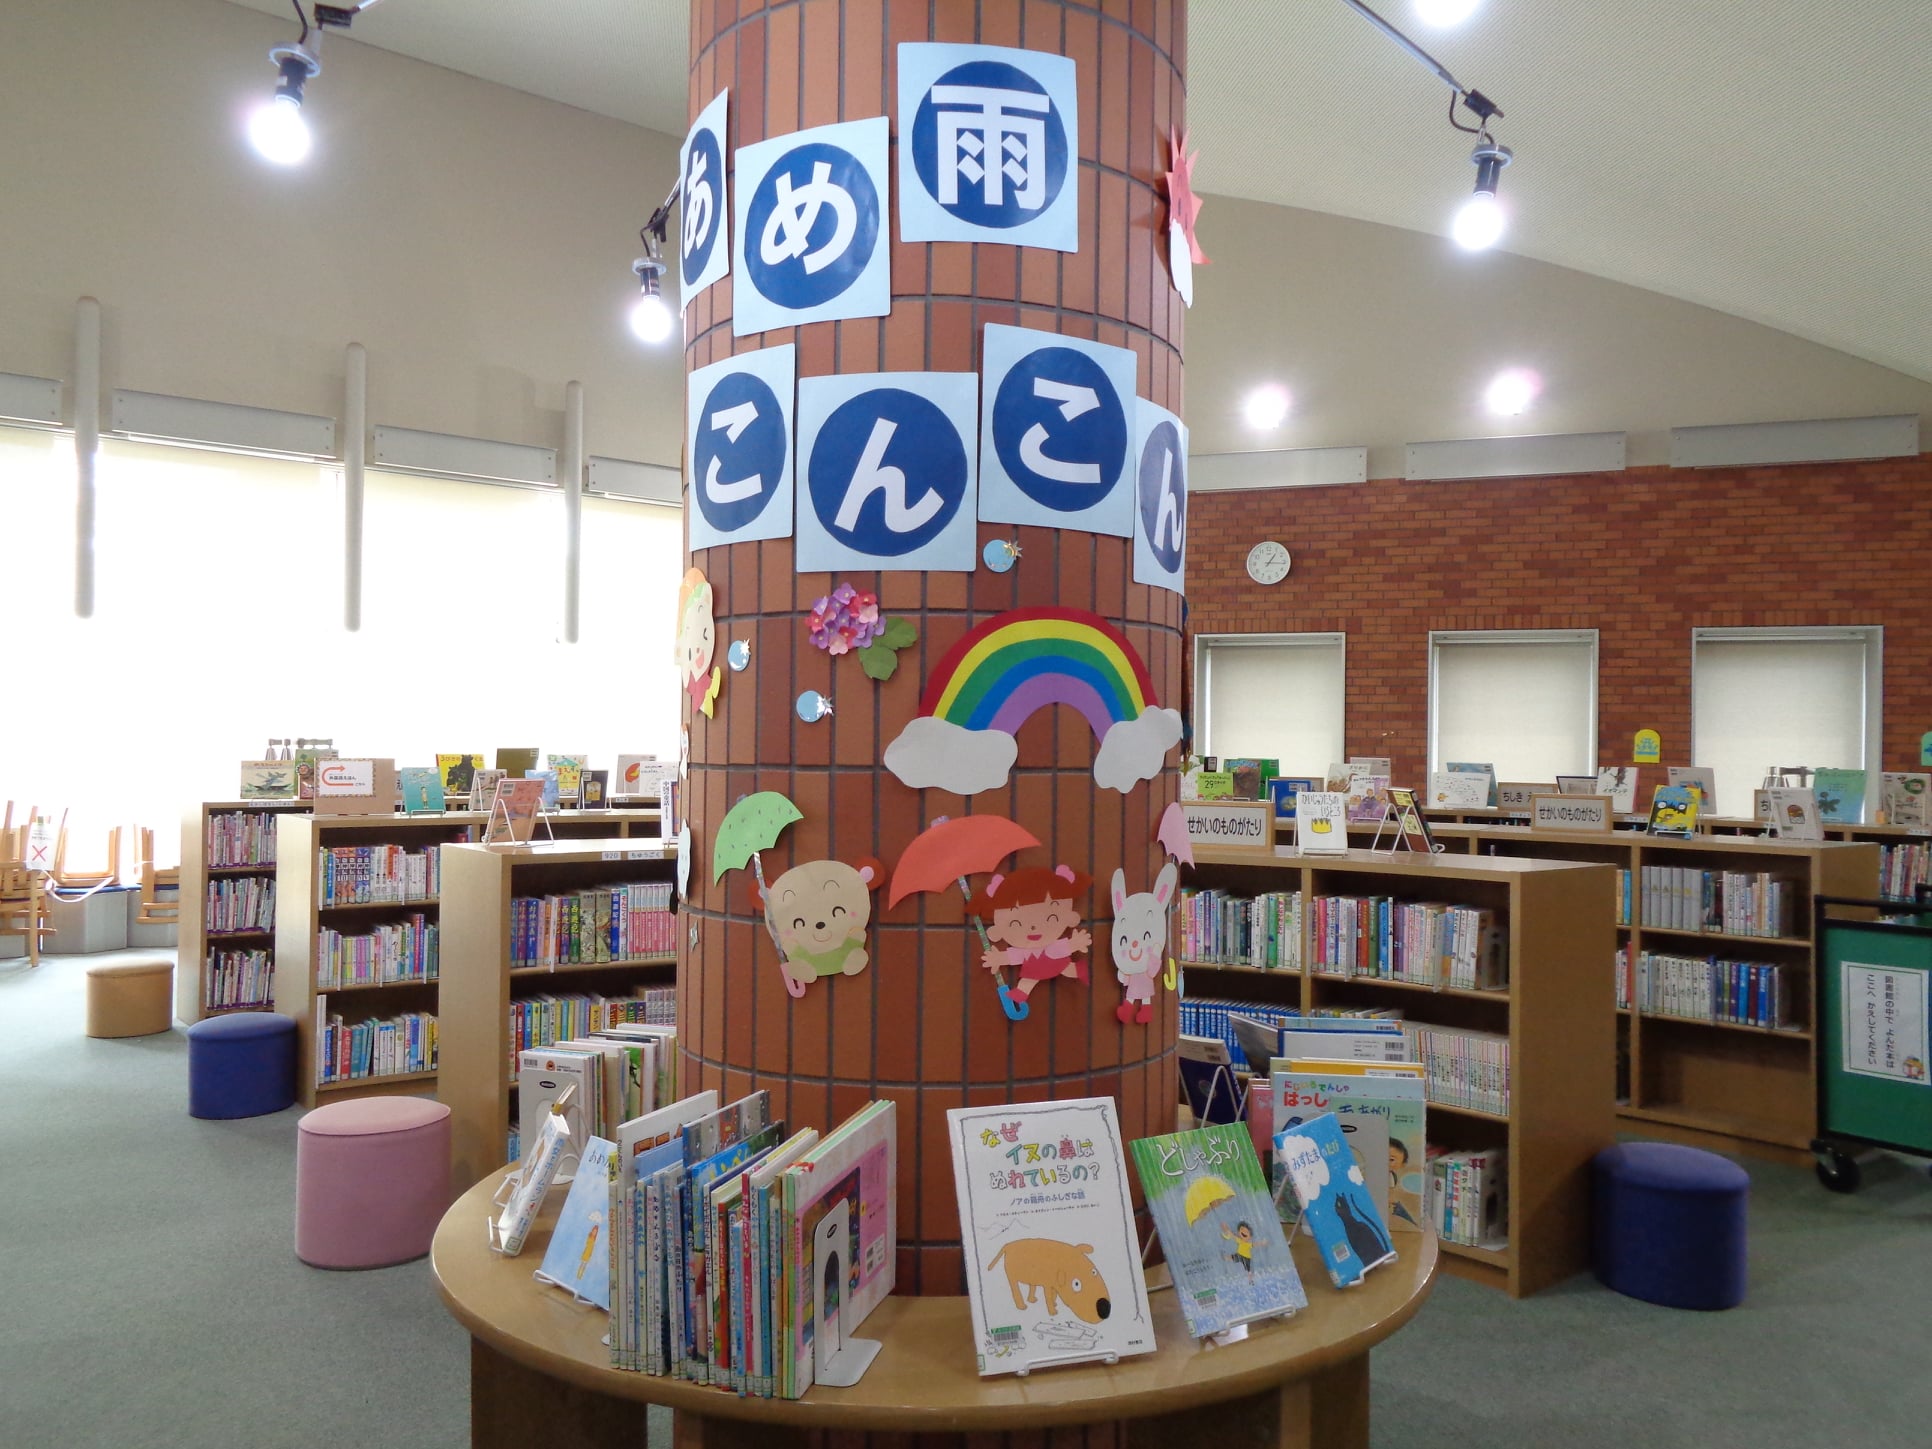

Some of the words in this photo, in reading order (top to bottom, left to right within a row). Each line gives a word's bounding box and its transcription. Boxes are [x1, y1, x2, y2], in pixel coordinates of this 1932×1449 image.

[1502, 791, 1523, 803] ちしき
[1187, 815, 1262, 837] せかいのものがたり
[1538, 804, 1602, 823] せかいのものがたり
[631, 851, 661, 859] ちゅうごく
[1866, 973, 1877, 998] ここへ
[1867, 1002, 1878, 1065] かえしてください
[1885, 1028, 1895, 1069] よんだ本は
[1283, 1091, 1329, 1108] はっし
[979, 1121, 1022, 1147] なぜ
[1006, 1138, 1094, 1166] イヌの鼻は
[1155, 1135, 1240, 1177] どしゃぶり
